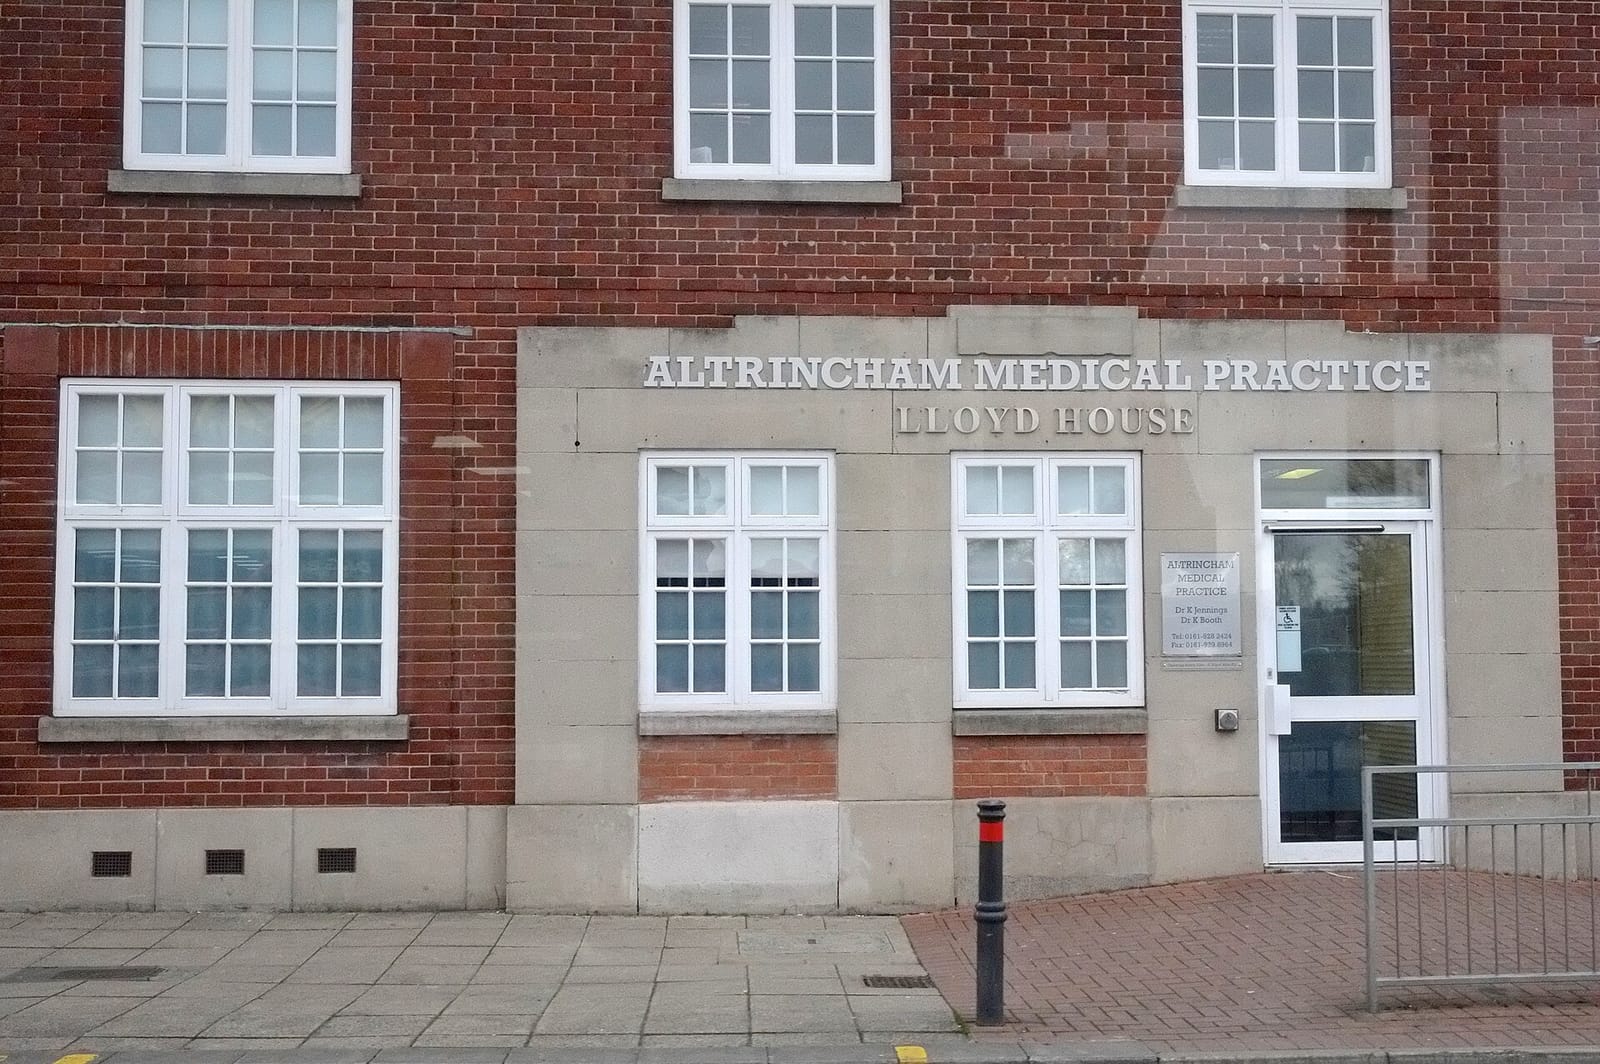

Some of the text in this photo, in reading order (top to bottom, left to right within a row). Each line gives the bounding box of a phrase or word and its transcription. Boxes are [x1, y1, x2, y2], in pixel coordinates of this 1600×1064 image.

[643, 355, 1431, 393] ALTRINCHAM MEDICAL PRACTICE
[897, 406, 1194, 434] LLOYD HOUSE
[1167, 560, 1234, 569] ALTRINCHAM
[1177, 573, 1225, 583] MEDICAL
[1175, 587, 1228, 596] PRACTICE
[1175, 606, 1228, 615] Dr K Jennings
[1181, 616, 1223, 624] Dr K Booth
